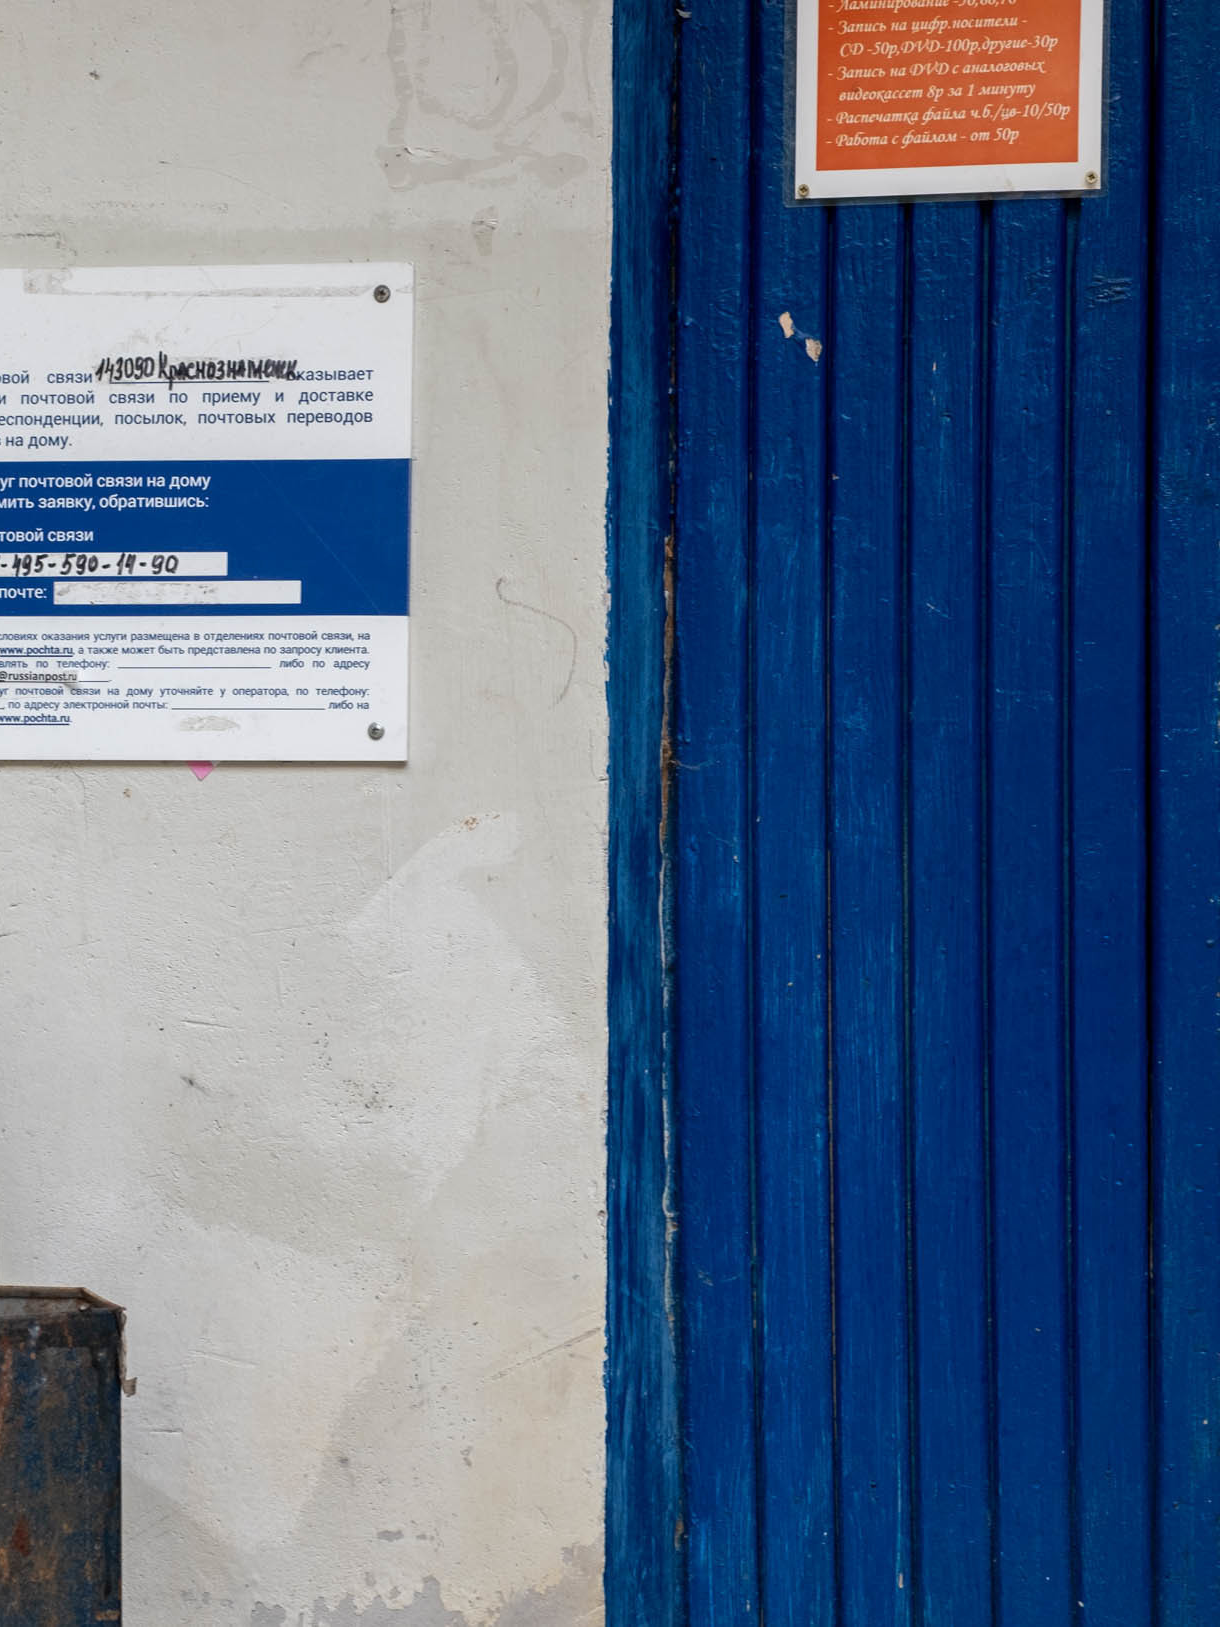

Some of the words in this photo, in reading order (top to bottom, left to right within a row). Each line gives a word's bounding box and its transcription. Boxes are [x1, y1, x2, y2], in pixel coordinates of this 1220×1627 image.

[837, 20, 887, 35] Запись
[890, 21, 908, 32] на
[911, 16, 1019, 34] цифр.носители
[839, 42, 865, 58] CD
[836, 66, 886, 81] Запись
[889, 67, 907, 77] на
[909, 61, 950, 77] DVD
[951, 64, 960, 75] с
[961, 60, 1047, 74] аналоговых
[838, 87, 924, 104] видеокассет
[926, 85, 945, 103] 8р
[947, 87, 963, 97] за
[966, 84, 975, 97] 1
[977, 83, 1037, 100] минуту
[835, 111, 919, 126] Распечатка
[920, 107, 967, 125] файла
[835, 132, 889, 147] Работа
[891, 135, 900, 145] с
[900, 130, 958, 149] файлом
[969, 131, 991, 142] от
[992, 127, 1020, 145] 50р
[95, 356, 155, 381] 143090
[46, 369, 94, 385] связи
[20, 389, 95, 405] почтовой
[108, 392, 155, 405] связи
[167, 391, 189, 404] по
[202, 391, 261, 407] приему
[274, 391, 285, 403] и
[297, 390, 374, 406] доставке
[114, 413, 187, 427] посылок,
[197, 412, 276, 425] почтовых
[286, 411, 373, 427] переводов
[5, 435, 24, 447] на
[27, 435, 73, 451] дому.
[18, 473, 94, 489] почтовой
[96, 476, 144, 488] связи
[146, 476, 166, 488] на
[168, 475, 212, 491] дому
[37, 497, 96, 512] заявку,
[98, 493, 210, 512] обратившись:
[47, 530, 94, 542] связи
[40, 633, 91, 641] оказания
[92, 633, 128, 644] услуги
[130, 632, 191, 643] размещена
[193, 632, 201, 641] в
[203, 632, 265, 643] отделениях
[267, 630, 318, 641] почтовой
[320, 632, 355, 642] связи,
[357, 632, 371, 641] на
[77, 647, 85, 655] а
[87, 646, 119, 655] также
[121, 646, 156, 655] может
[157, 644, 186, 655] быть
[187, 646, 261, 657] представлена
[263, 646, 277, 655] по
[279, 646, 323, 657] запросу
[324, 646, 370, 655] клиента.
[35, 660, 50, 669] по
[55, 658, 110, 671] телефону:
[278, 658, 305, 669] либо
[311, 660, 326, 669] по
[332, 660, 371, 671] адресу
[14, 685, 65, 696] почтовой
[69, 685, 101, 696] связи
[106, 687, 120, 696] на
[125, 687, 154, 698] дому
[159, 685, 214, 698] уточняйте
[219, 688, 227, 698] у
[231, 687, 290, 698] оператора,
[295, 688, 309, 696] по
[315, 685, 370, 699] телефону:
[7, 701, 22, 710] по
[23, 701, 61, 712] адресу
[62, 699, 130, 712] электронной
[132, 701, 169, 710] почты:
[327, 699, 355, 710] либо
[356, 701, 370, 710] на
